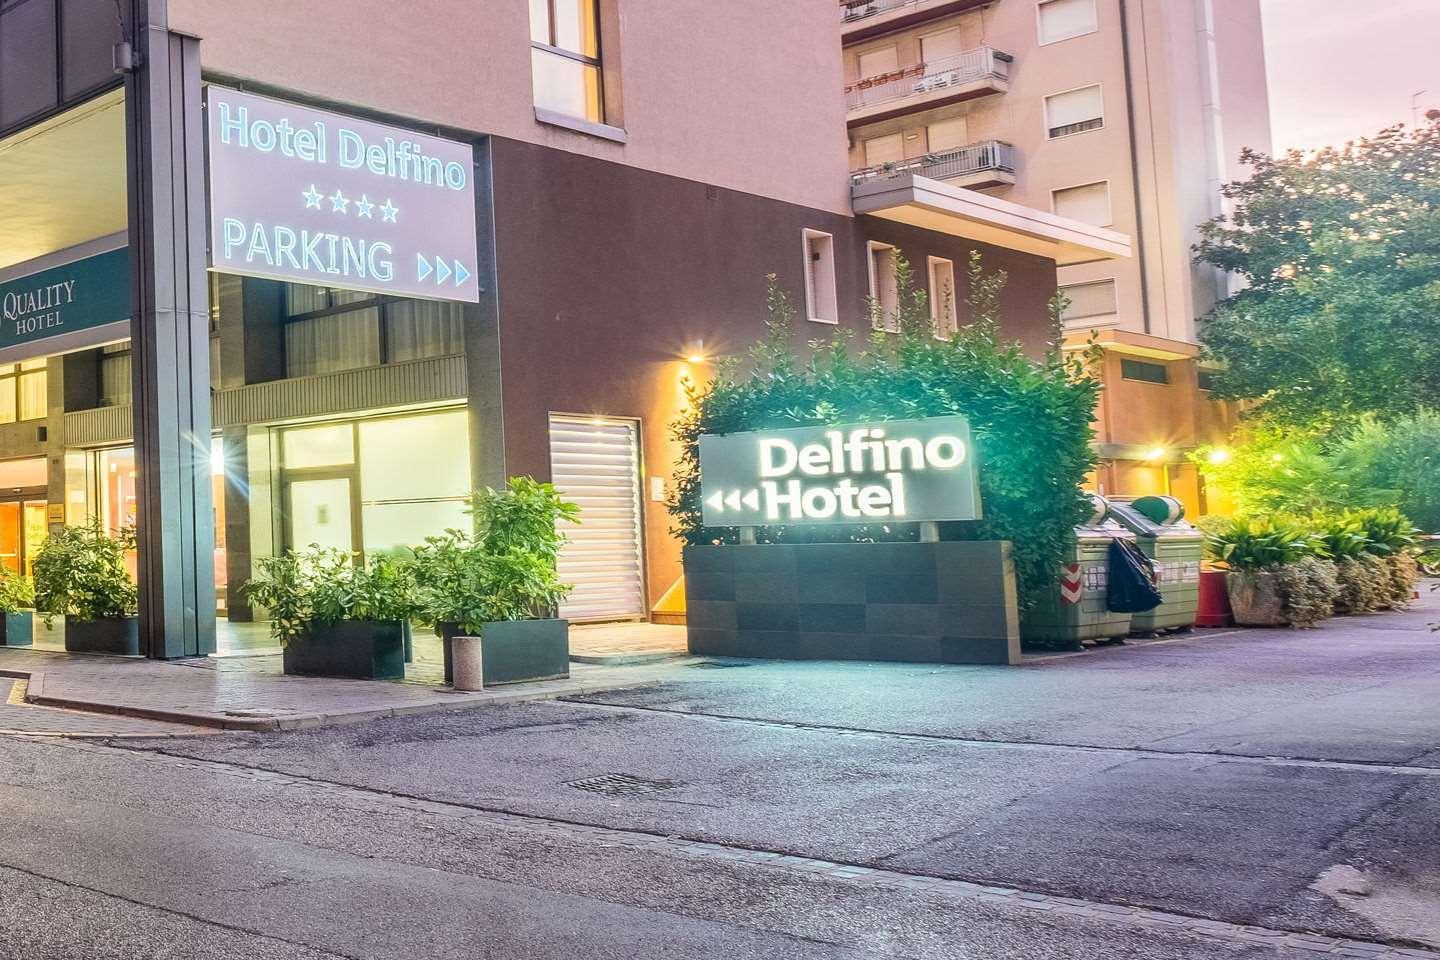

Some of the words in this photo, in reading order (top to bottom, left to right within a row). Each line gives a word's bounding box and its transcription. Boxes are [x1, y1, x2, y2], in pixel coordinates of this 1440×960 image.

[218, 101, 327, 163] Hotel
[338, 128, 466, 191] Delfino
[223, 218, 394, 282] PARKING
[3, 279, 76, 321] QUALITY
[16, 310, 64, 336] HOTEL
[758, 427, 966, 478] Delfino
[761, 472, 907, 520] Hotel
